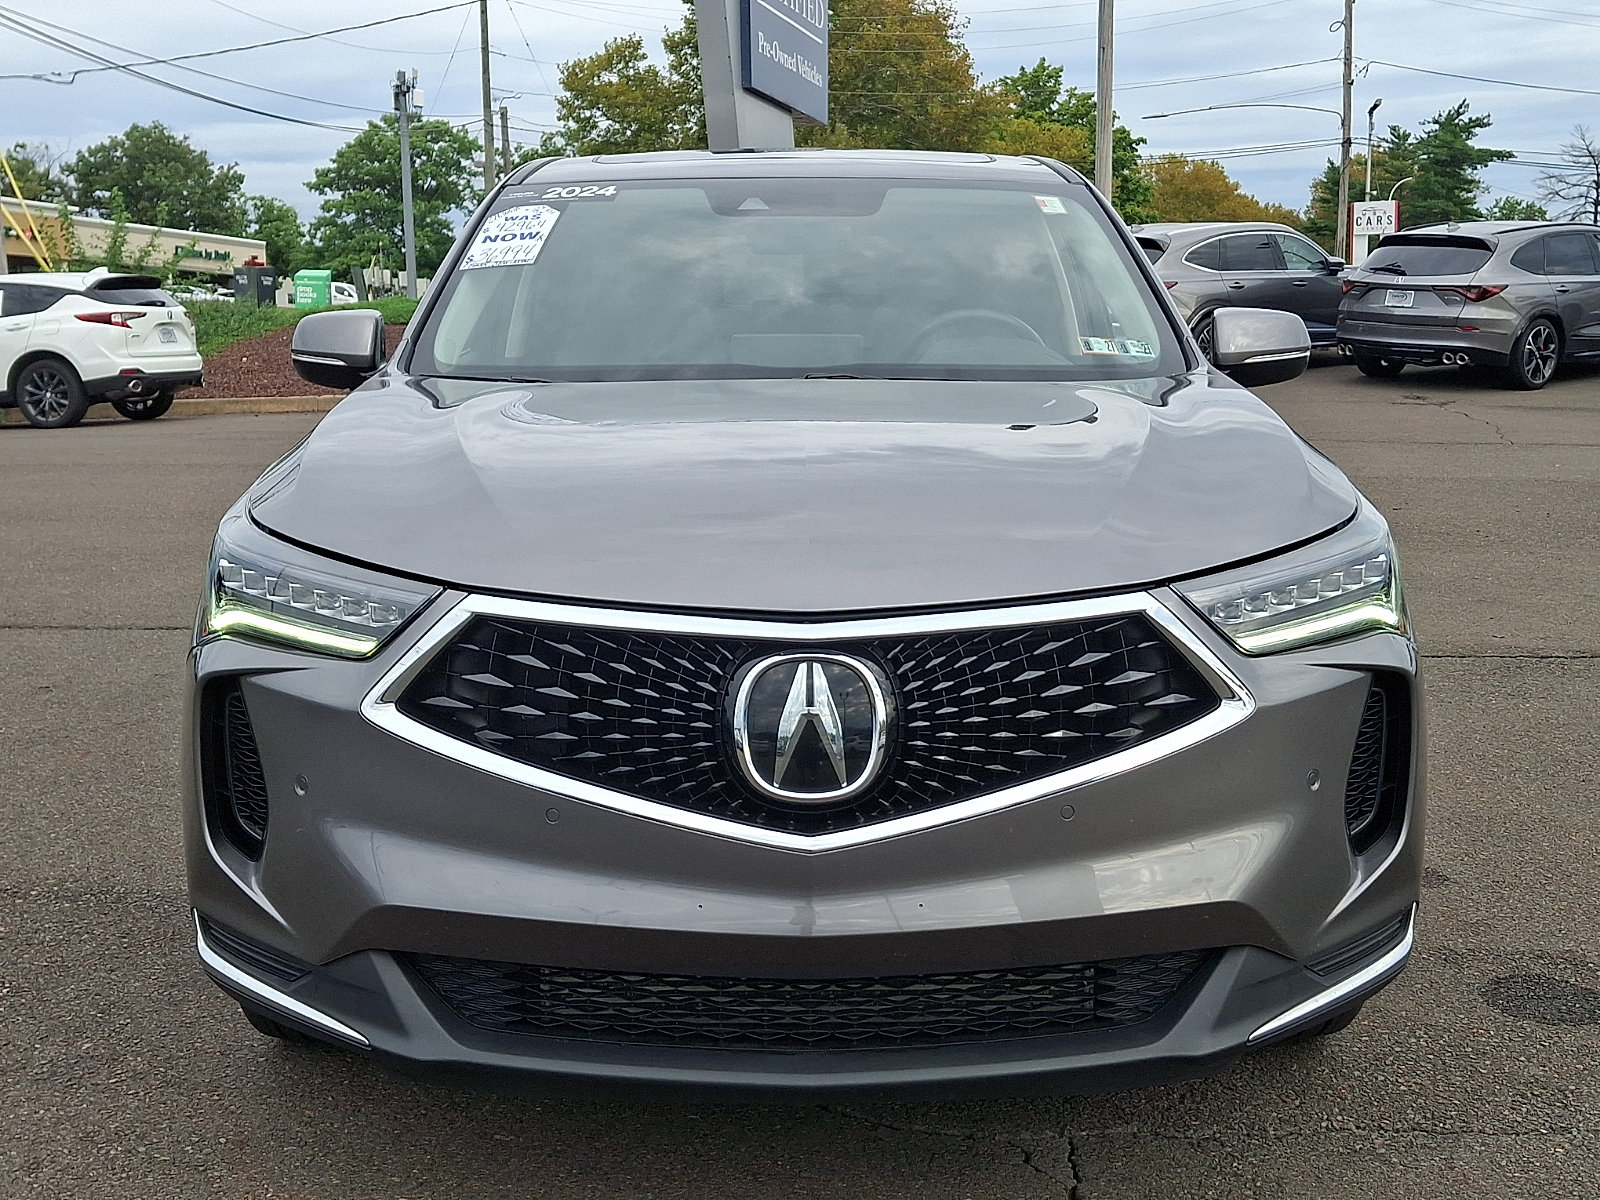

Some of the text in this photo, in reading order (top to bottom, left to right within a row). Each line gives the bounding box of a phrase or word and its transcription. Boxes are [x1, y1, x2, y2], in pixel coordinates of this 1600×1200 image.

[757, 31, 823, 87] Pre-Owned Vehicles
[541, 185, 617, 199] 2024
[504, 213, 542, 222] WAS
[1356, 214, 1393, 227] CARS
[481, 231, 541, 244] NOW
